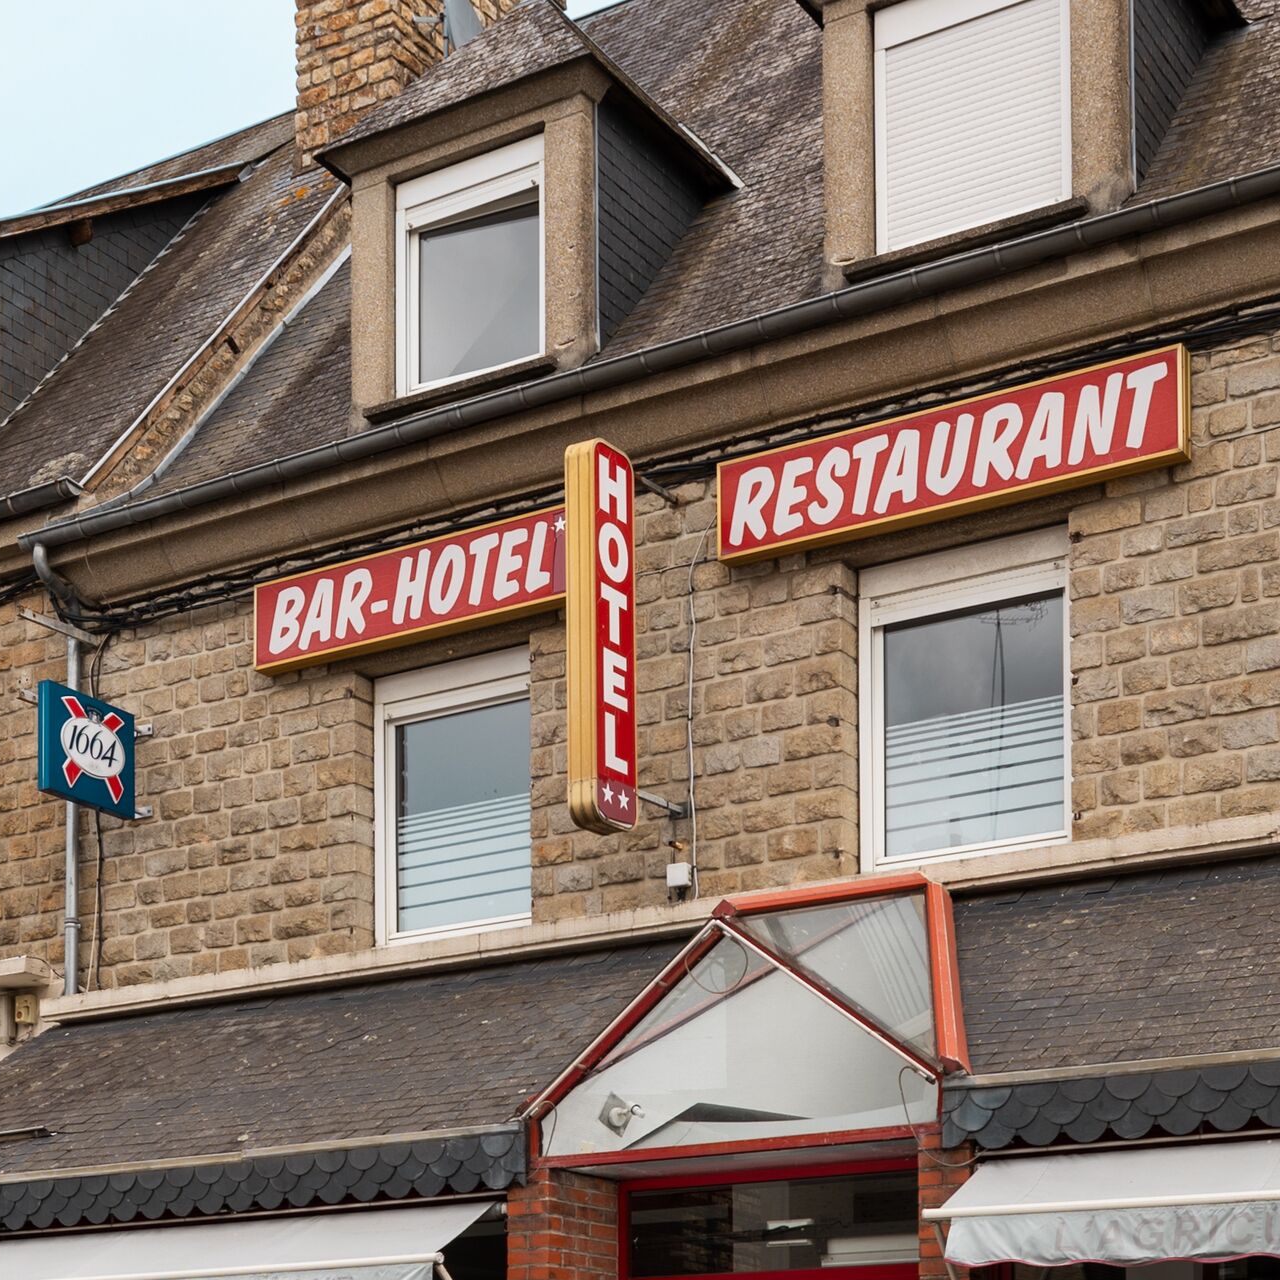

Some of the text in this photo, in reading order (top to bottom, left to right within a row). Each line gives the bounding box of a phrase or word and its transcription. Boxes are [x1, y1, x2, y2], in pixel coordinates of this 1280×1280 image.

[729, 361, 1168, 547] RESTAURANT
[268, 520, 551, 655] BAR-HOTEL
[598, 453, 629, 776] HOTEL
[69, 725, 118, 768] 1664
